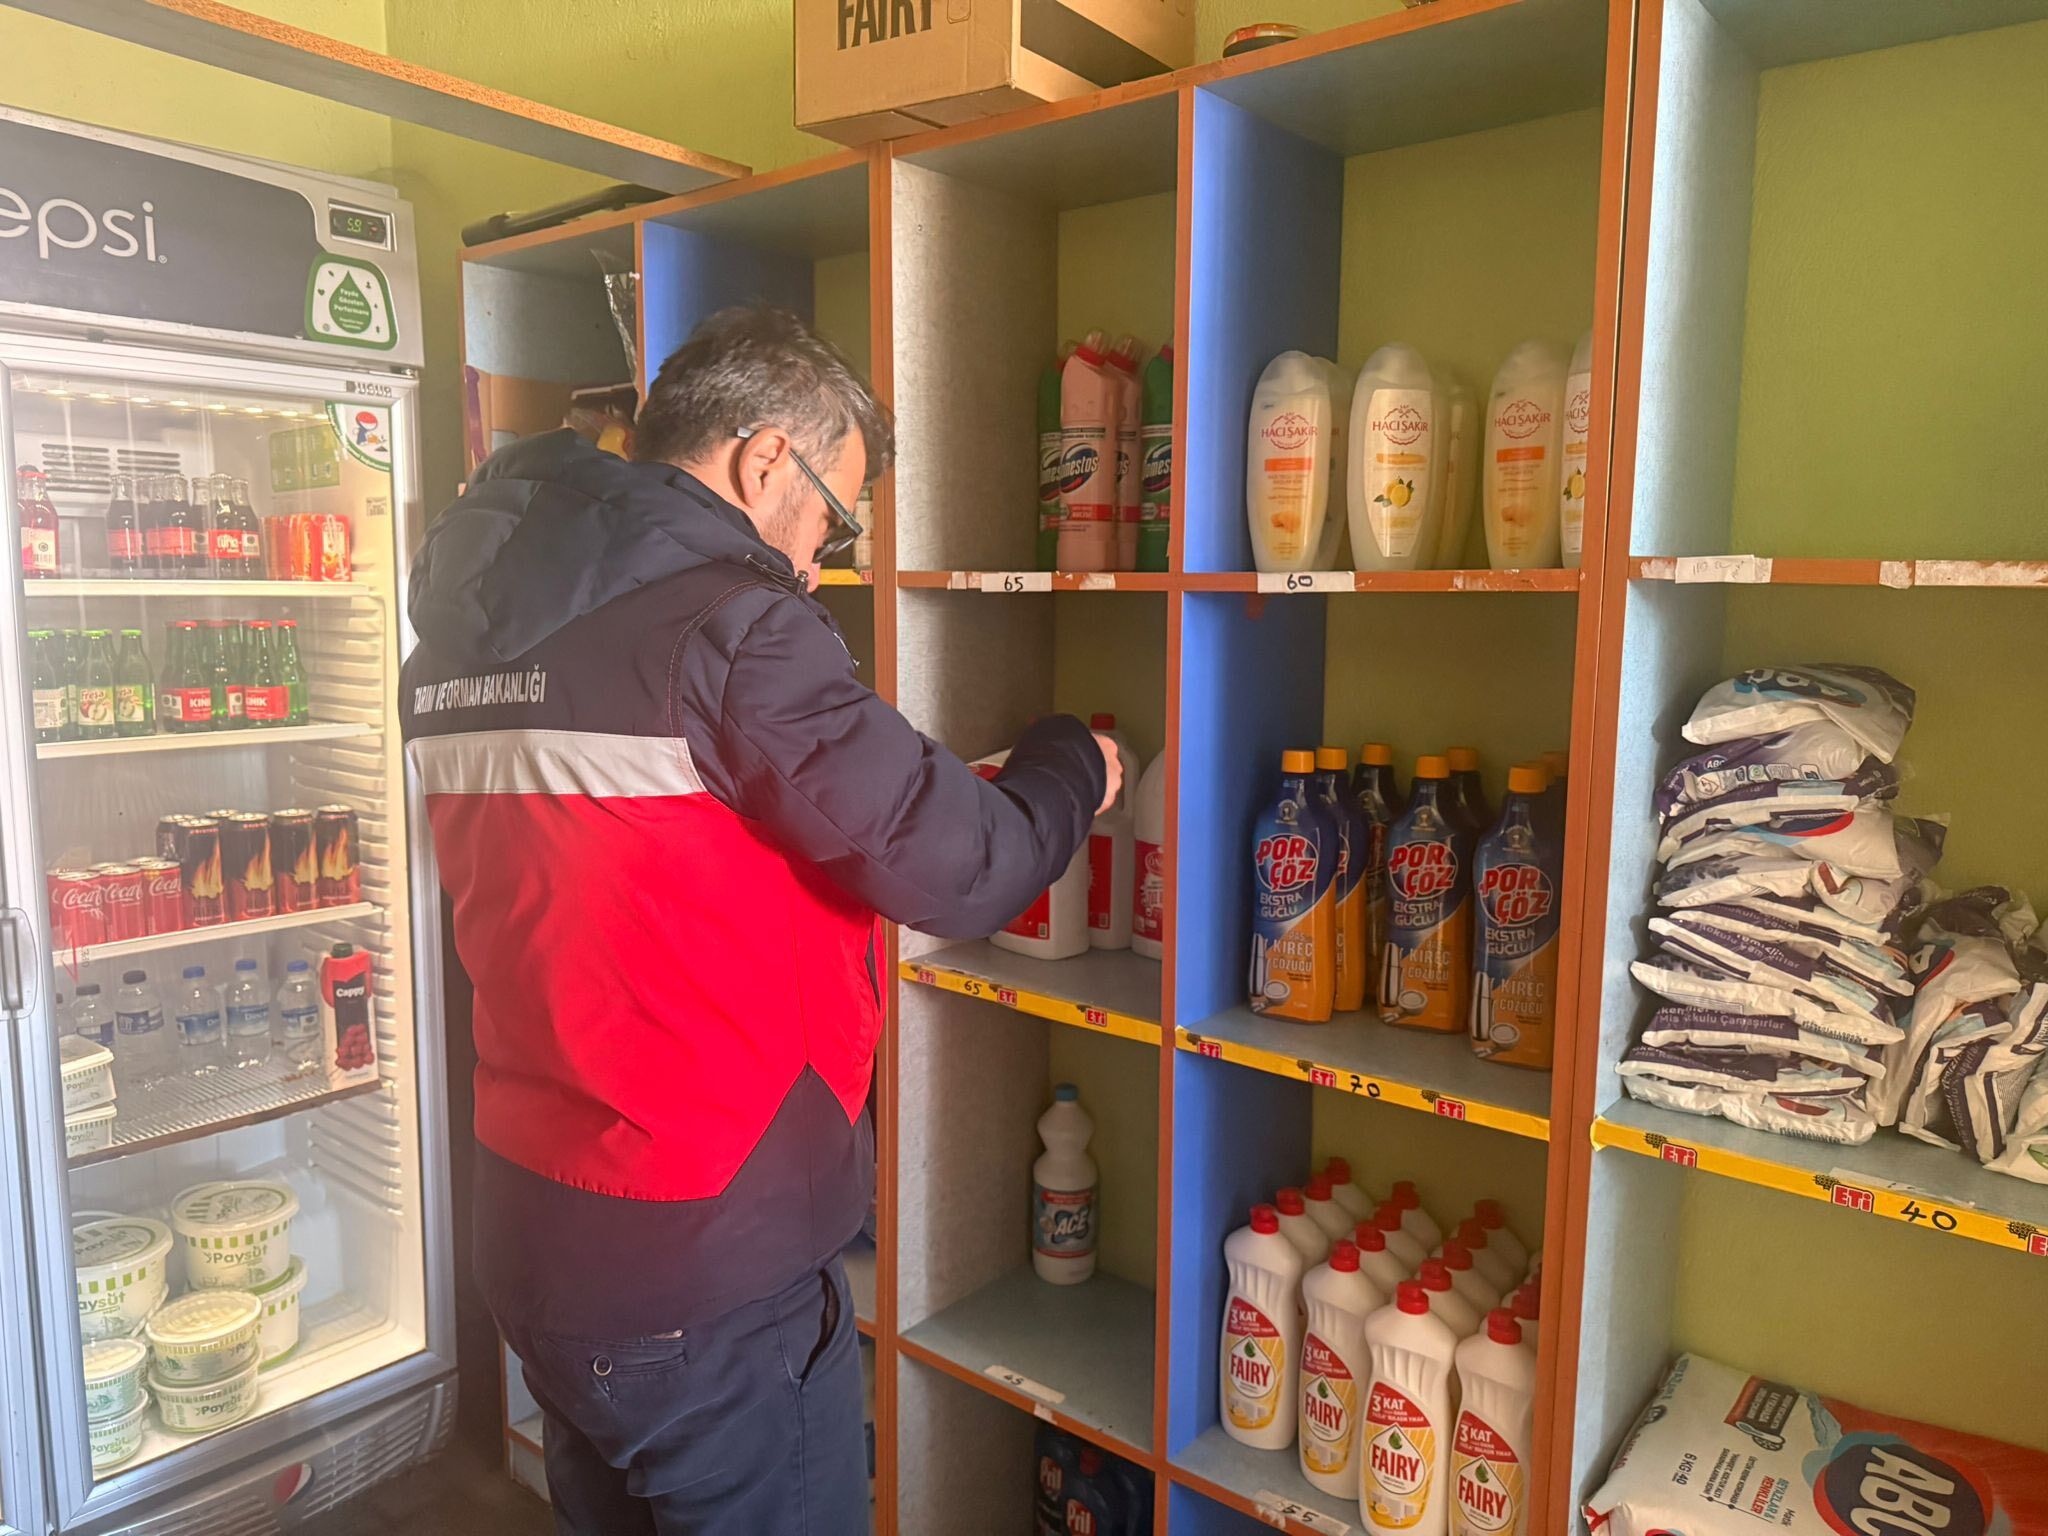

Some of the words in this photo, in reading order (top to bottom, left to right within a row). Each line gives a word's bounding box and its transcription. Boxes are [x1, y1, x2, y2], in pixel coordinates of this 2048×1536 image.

[1004, 576, 1024, 592] 65
[1287, 574, 1313, 590] 60
[414, 684, 437, 715] TARIM
[446, 676, 483, 709] ORMAN
[482, 664, 546, 705] BAKANLIĞI
[1256, 837, 1307, 864] POR
[1390, 843, 1445, 873] POR
[1480, 867, 1540, 895] POR
[1260, 892, 1303, 906] EKSTRA
[964, 980, 982, 995] 65
[1350, 1075, 1381, 1097] 70
[1055, 1210, 1089, 1236] ACE
[1900, 1201, 1957, 1231] 40
[1231, 1308, 1238, 1324] 3
[1239, 1311, 1258, 1322] KAT
[1304, 1345, 1312, 1362] 3
[1313, 1349, 1331, 1361] KAT
[1230, 1353, 1271, 1387] FAIRY
[1372, 1394, 1382, 1412] 3
[1383, 1397, 1406, 1410] KAT
[1304, 1398, 1344, 1431] FAIRY
[1460, 1423, 1469, 1442] 3
[1470, 1427, 1493, 1442] KAT
[1371, 1444, 1420, 1483] FAIRY
[1679, 1459, 1694, 1474] KG
[1684, 1452, 1697, 1462] 6
[1676, 1472, 1690, 1485] 40
[1458, 1475, 1507, 1519] FAIRY
[1066, 1506, 1091, 1535] Pril
